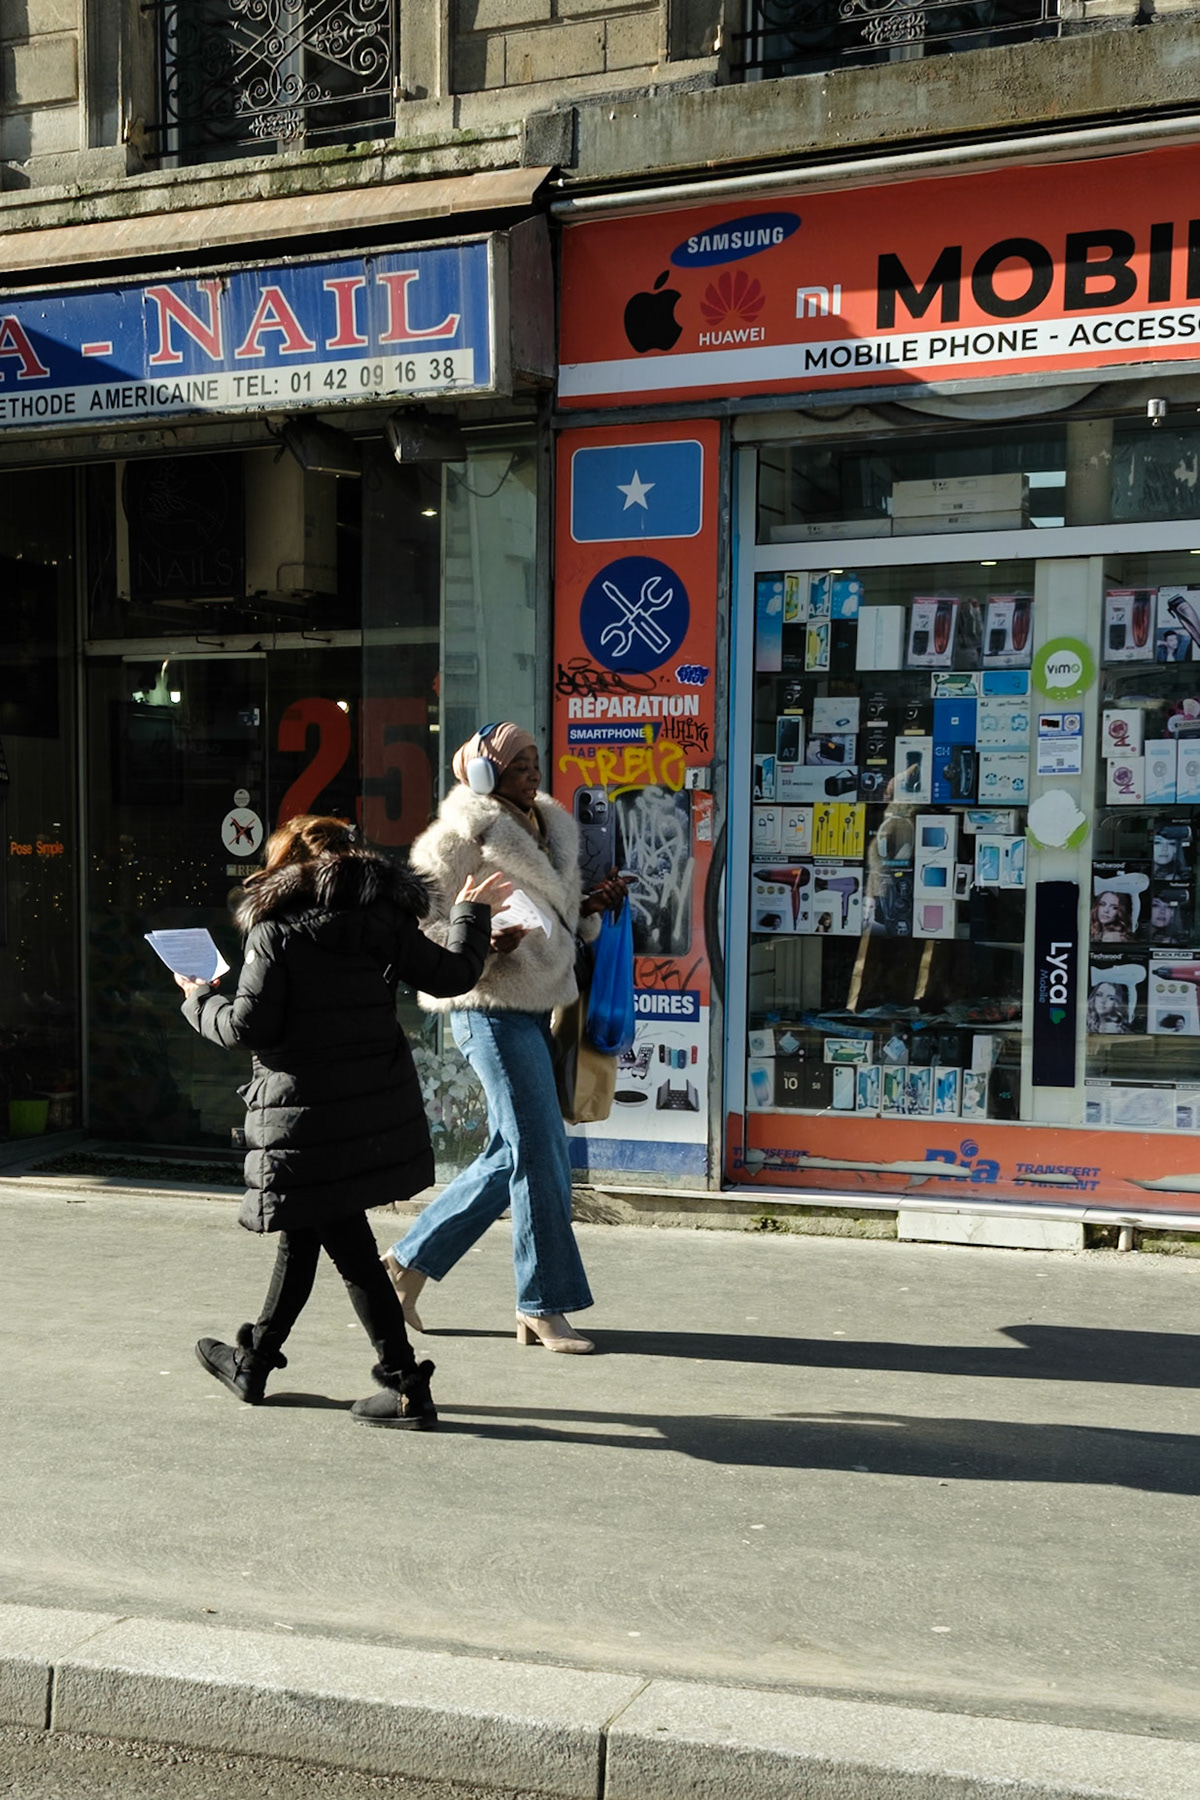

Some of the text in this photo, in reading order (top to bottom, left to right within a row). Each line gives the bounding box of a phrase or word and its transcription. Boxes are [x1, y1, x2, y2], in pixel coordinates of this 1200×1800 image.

[687, 226, 784, 254] SAMSUNG
[875, 219, 1200, 329] MOBI
[144, 269, 461, 366] NAIL
[699, 327, 765, 346] HUAWEI
[804, 340, 918, 370] MOBILE
[929, 328, 1038, 359] PHONE
[1068, 314, 1200, 347] ACCESS
[90, 379, 218, 411] AMERICAINE
[233, 376, 278, 397] TEL:
[290, 371, 311, 393] 01
[323, 368, 347, 390] 42
[360, 364, 384, 387] 09
[395, 360, 416, 383] 16
[430, 356, 455, 380] 38
[138, 549, 234, 587] NAILS
[568, 693, 699, 719] RÉPARATION
[276, 697, 432, 847] 25
[10, 841, 33, 855] Pose
[1039, 969, 1048, 1003] Mobile
[1045, 942, 1073, 1004] Lyca
[784, 1078, 798, 1089] 10
